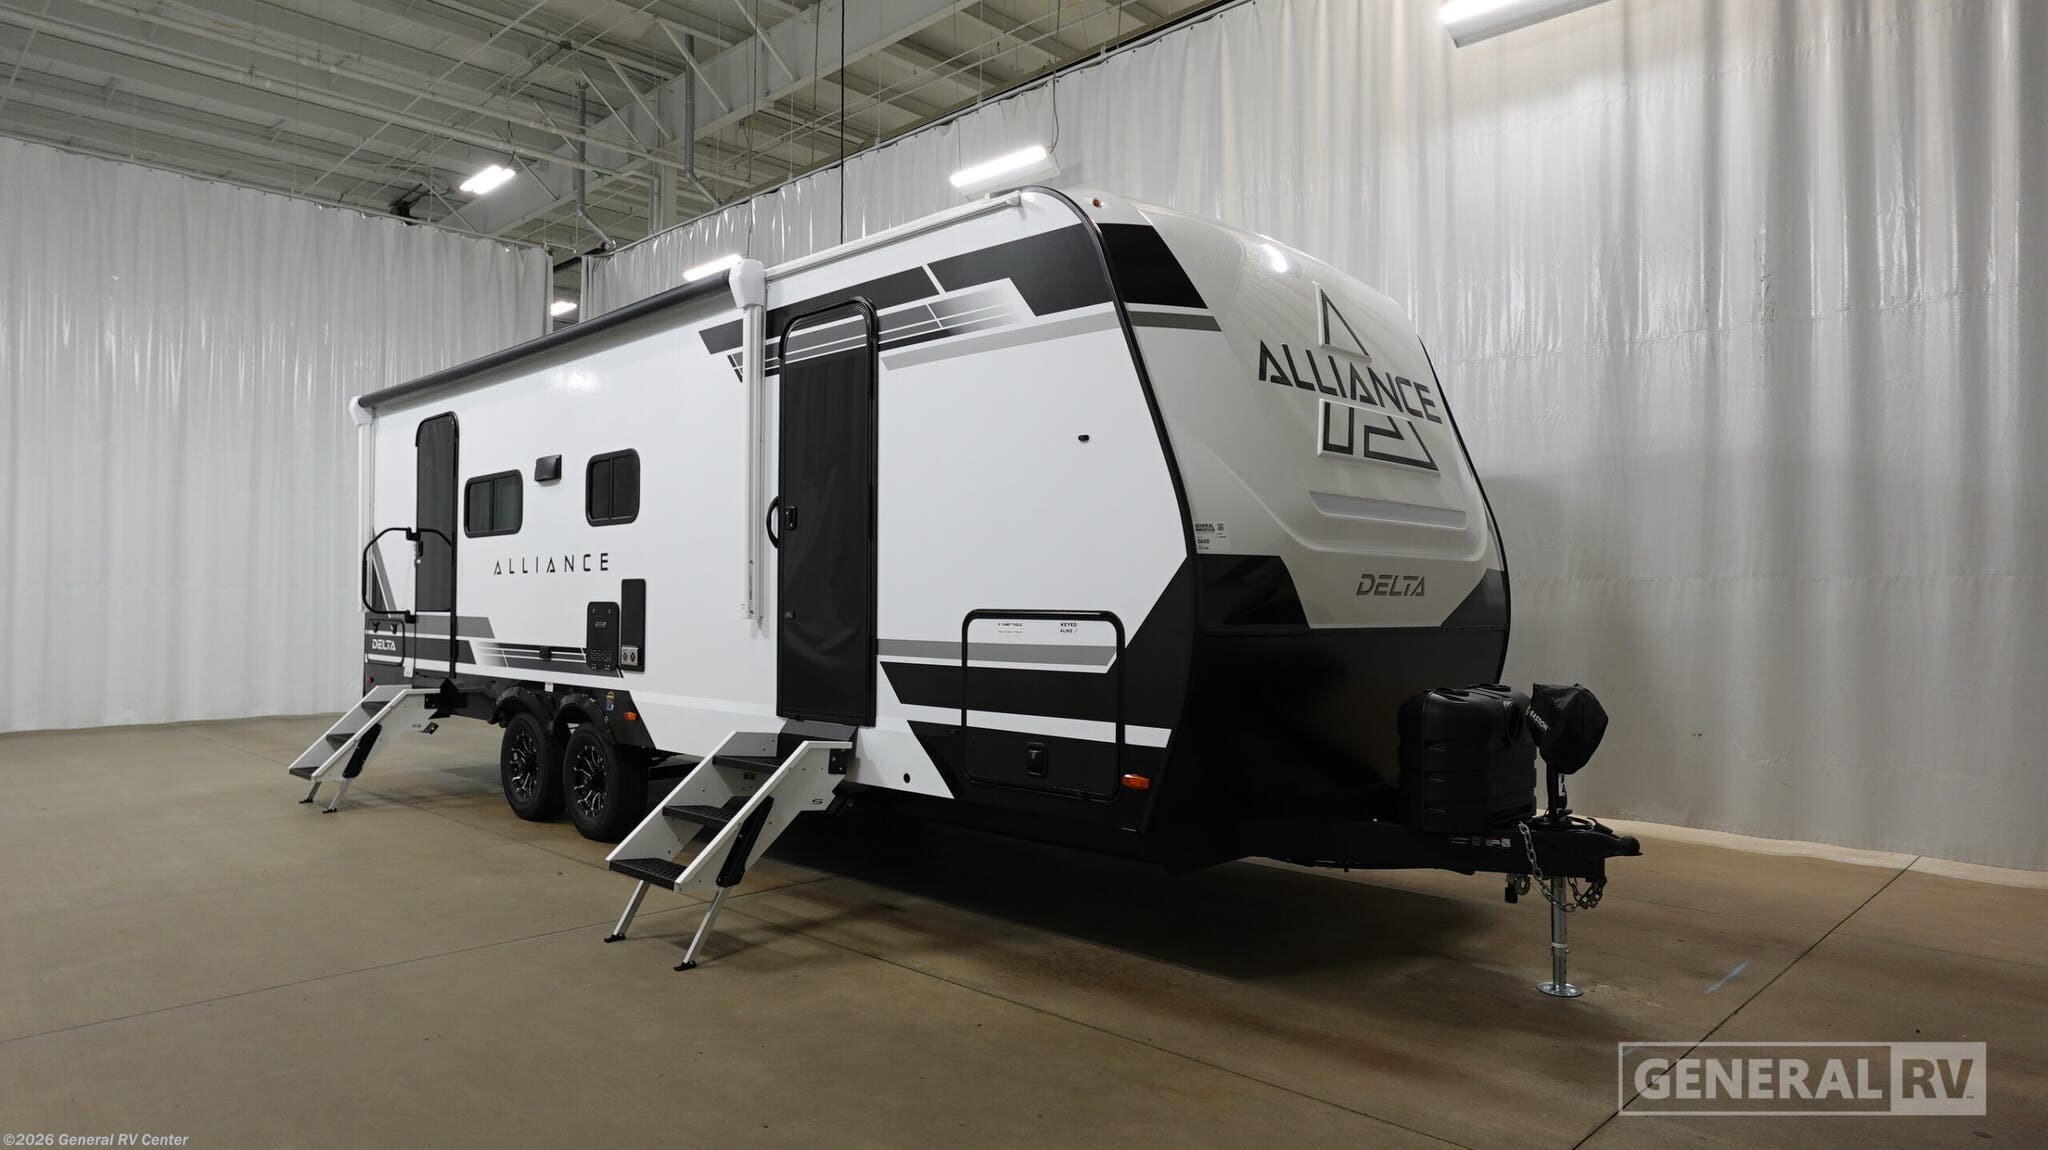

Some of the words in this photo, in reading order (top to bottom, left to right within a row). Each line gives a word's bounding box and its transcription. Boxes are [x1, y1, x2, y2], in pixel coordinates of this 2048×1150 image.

[1258, 339, 1443, 424] ALLIANCE
[493, 552, 609, 575] ALLIANCE
[1356, 573, 1425, 597] DELTA
[371, 638, 397, 651] DELTA
